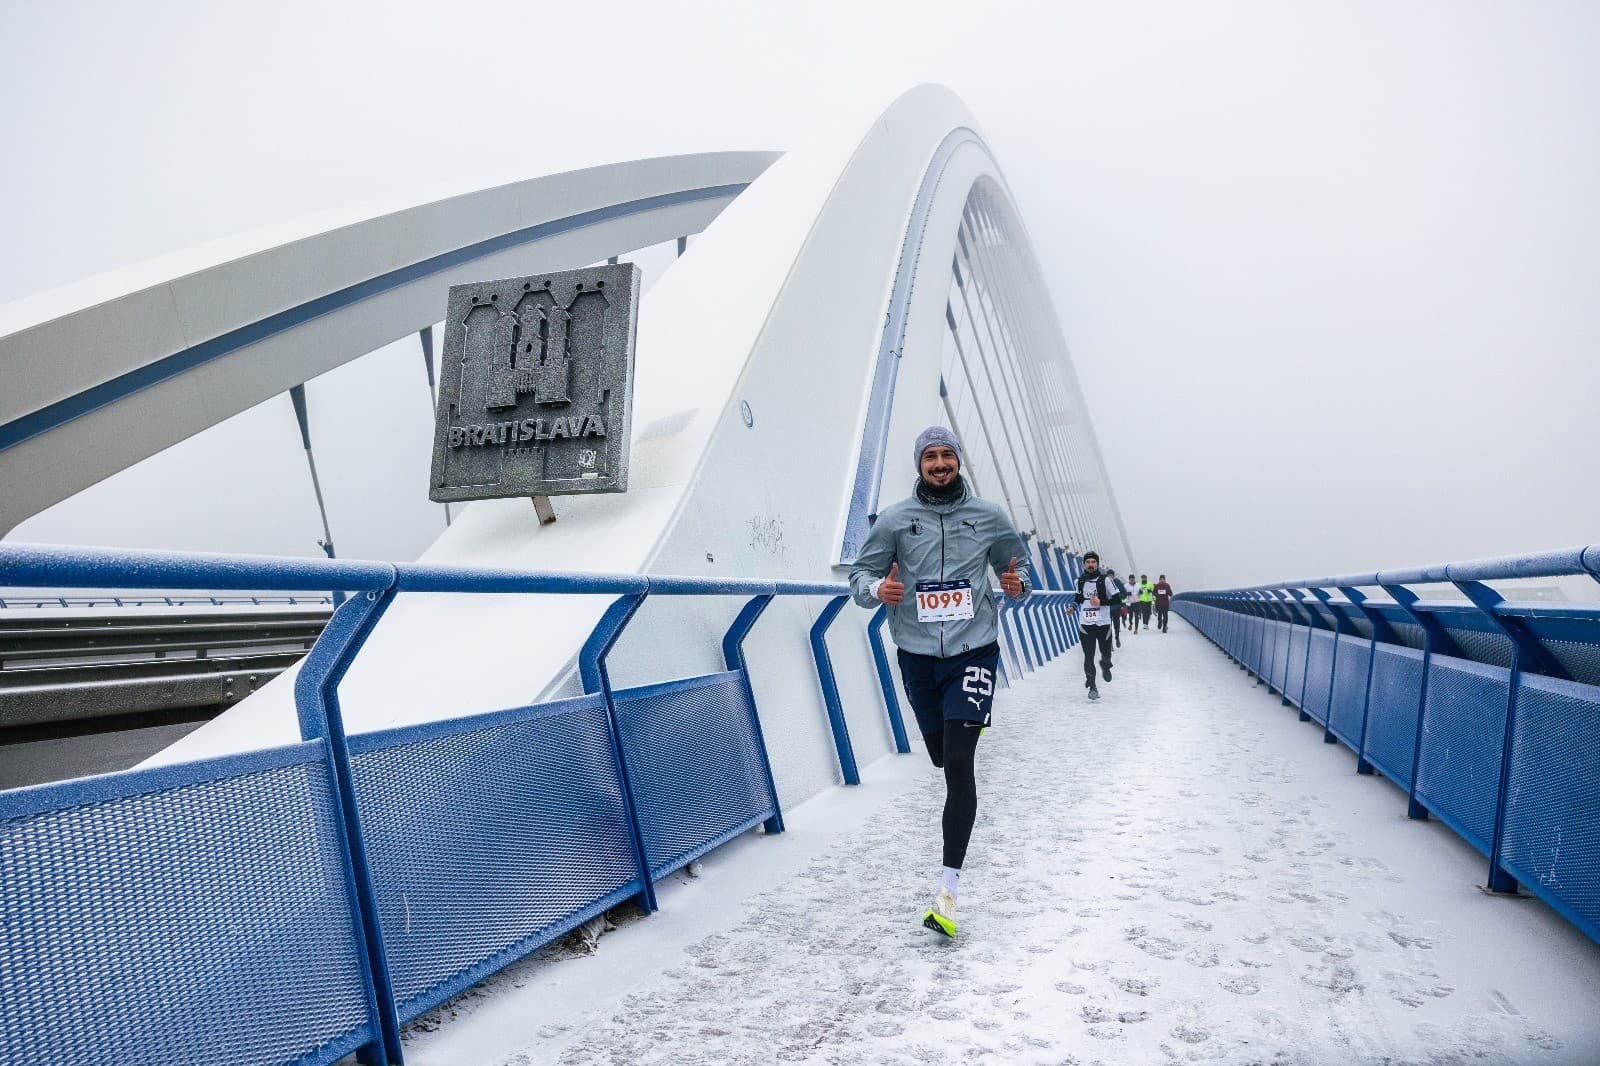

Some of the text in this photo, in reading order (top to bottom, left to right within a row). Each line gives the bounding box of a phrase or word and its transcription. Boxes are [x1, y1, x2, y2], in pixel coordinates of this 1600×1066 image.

[448, 415, 607, 448] BRATISLAVA
[918, 591, 963, 610] 1099
[962, 665, 993, 697] 25
